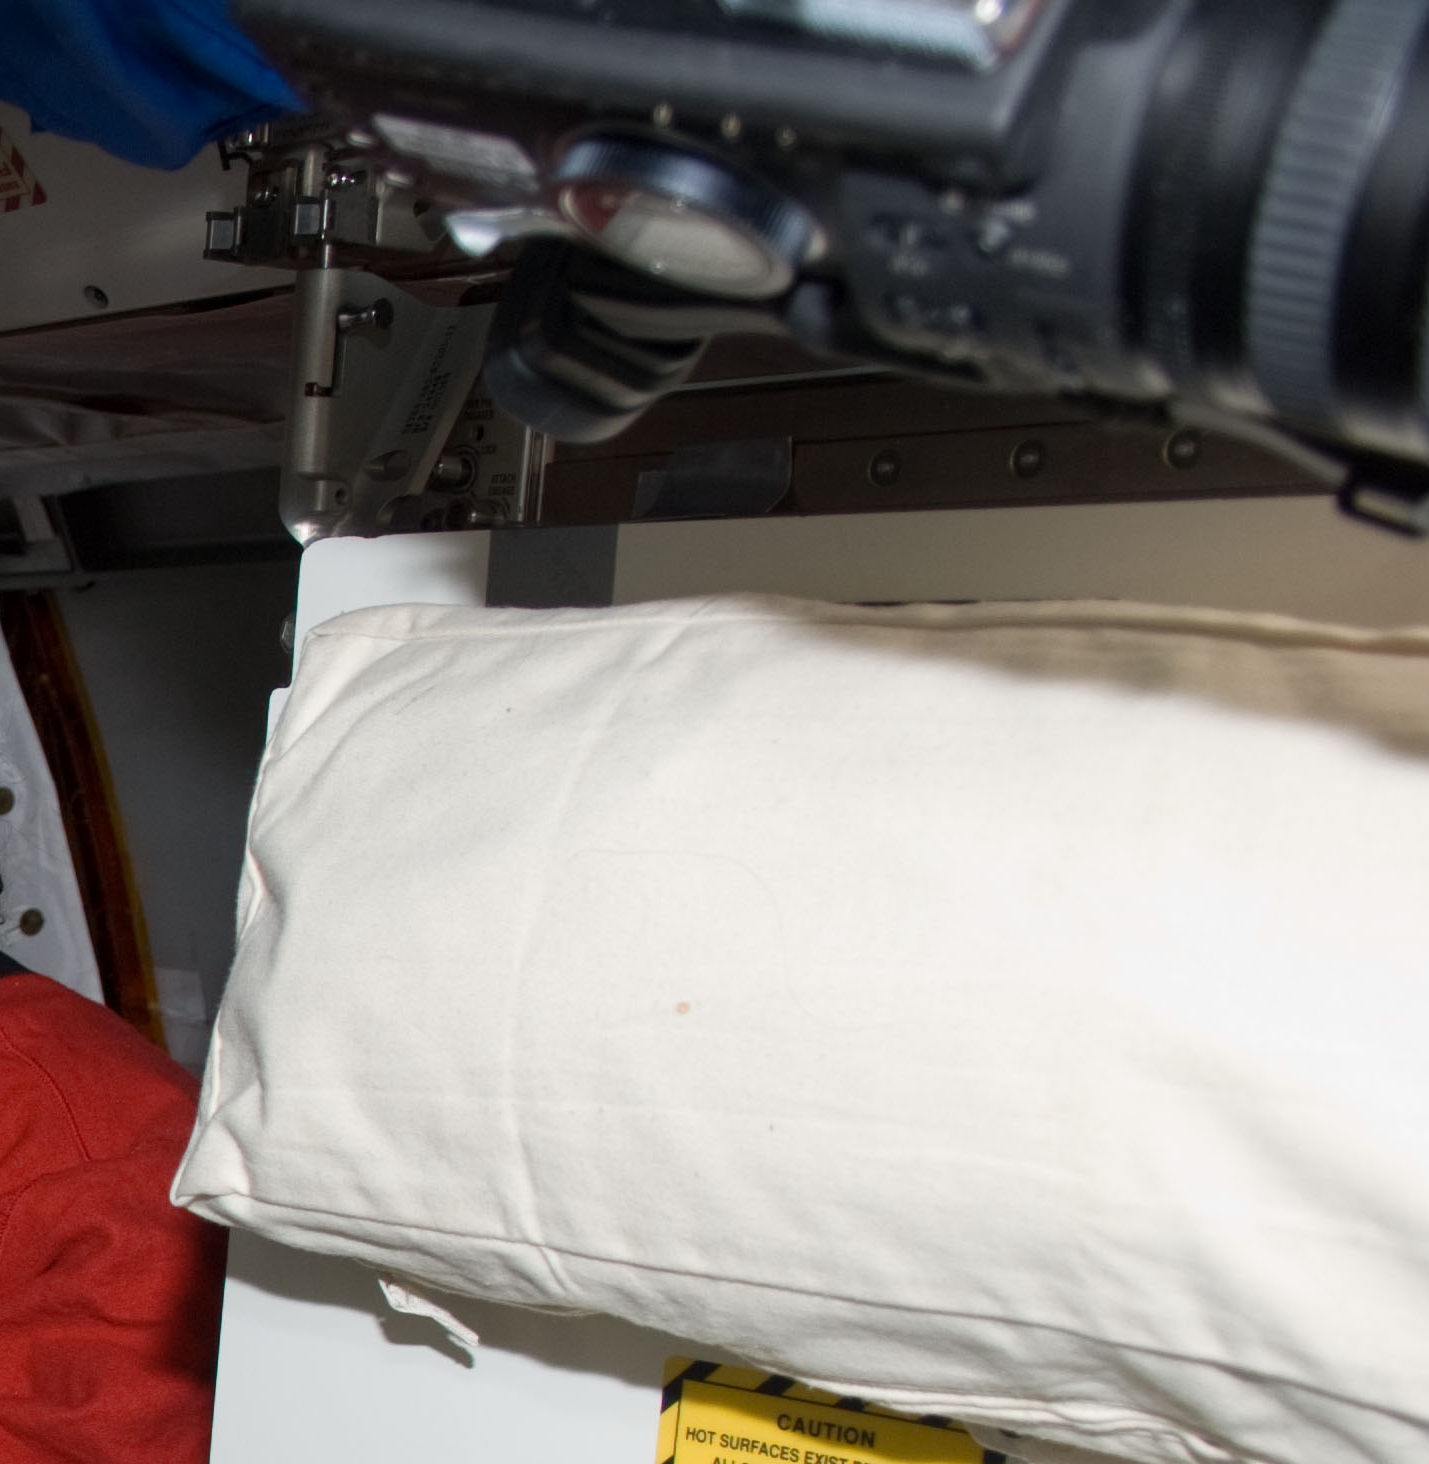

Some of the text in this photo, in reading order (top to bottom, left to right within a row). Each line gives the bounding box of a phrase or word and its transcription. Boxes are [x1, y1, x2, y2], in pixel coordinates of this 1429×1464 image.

[686, 1427, 716, 1446] HOT
[720, 1434, 800, 1463] SURFACES
[777, 1414, 876, 1448] CAUTION
